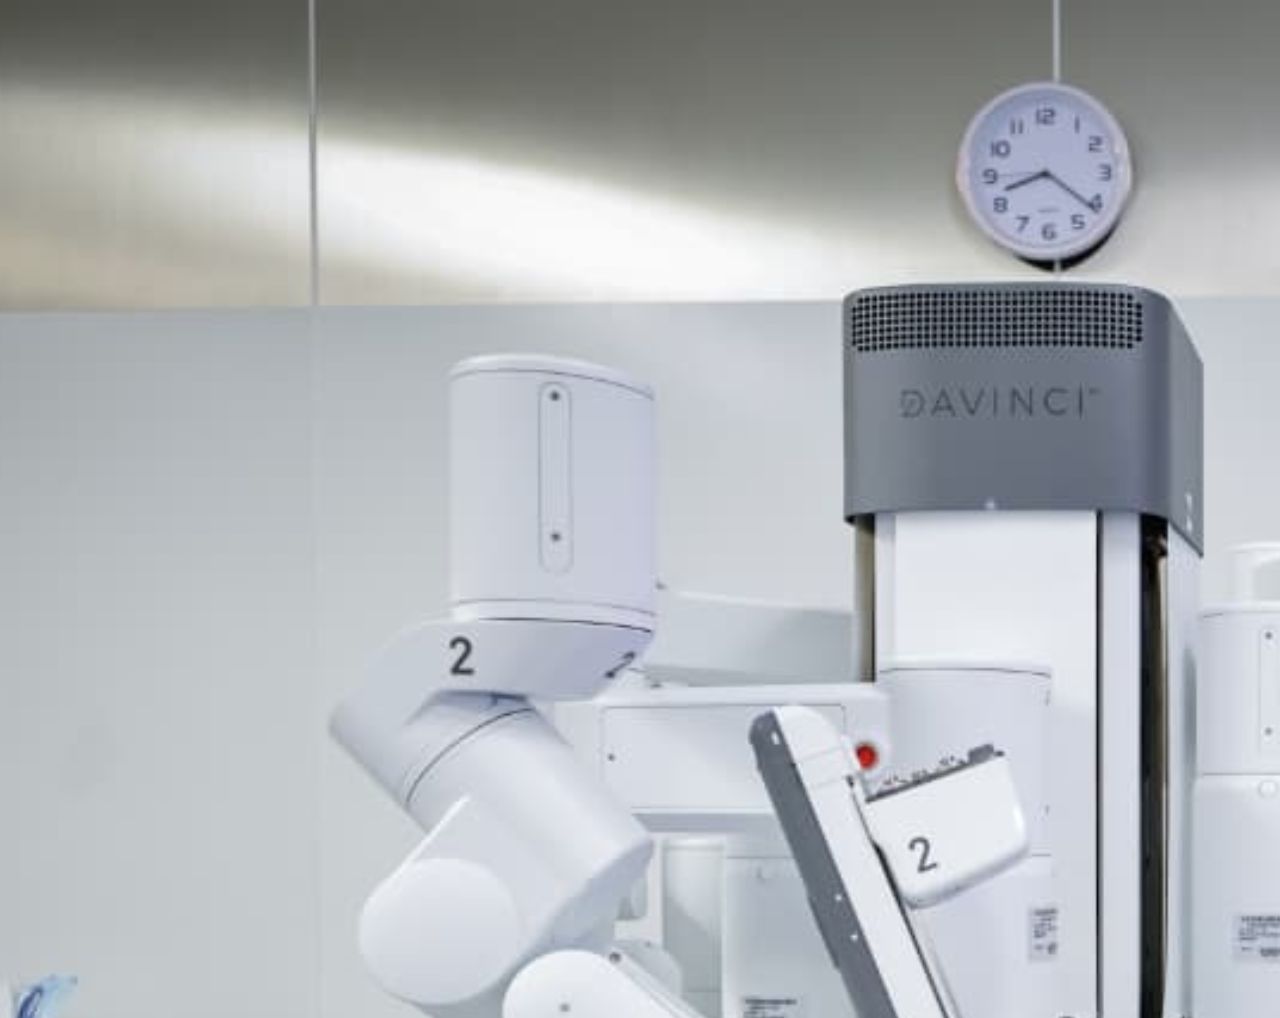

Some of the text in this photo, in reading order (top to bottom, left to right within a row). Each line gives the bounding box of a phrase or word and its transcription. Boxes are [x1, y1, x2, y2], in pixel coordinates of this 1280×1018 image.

[1035, 109, 1055, 125] 12
[1009, 119, 1024, 134] 11
[990, 140, 1011, 158] 10
[1088, 135, 1103, 152] 2
[982, 168, 998, 184] 9
[1099, 164, 1112, 181] 3
[994, 197, 1008, 213] 8
[1090, 193, 1103, 211] 4
[1016, 215, 1029, 231] 7
[1071, 214, 1085, 229] 5
[1042, 224, 1056, 240] 6
[450, 636, 475, 676] 2
[908, 836, 938, 873] 2
